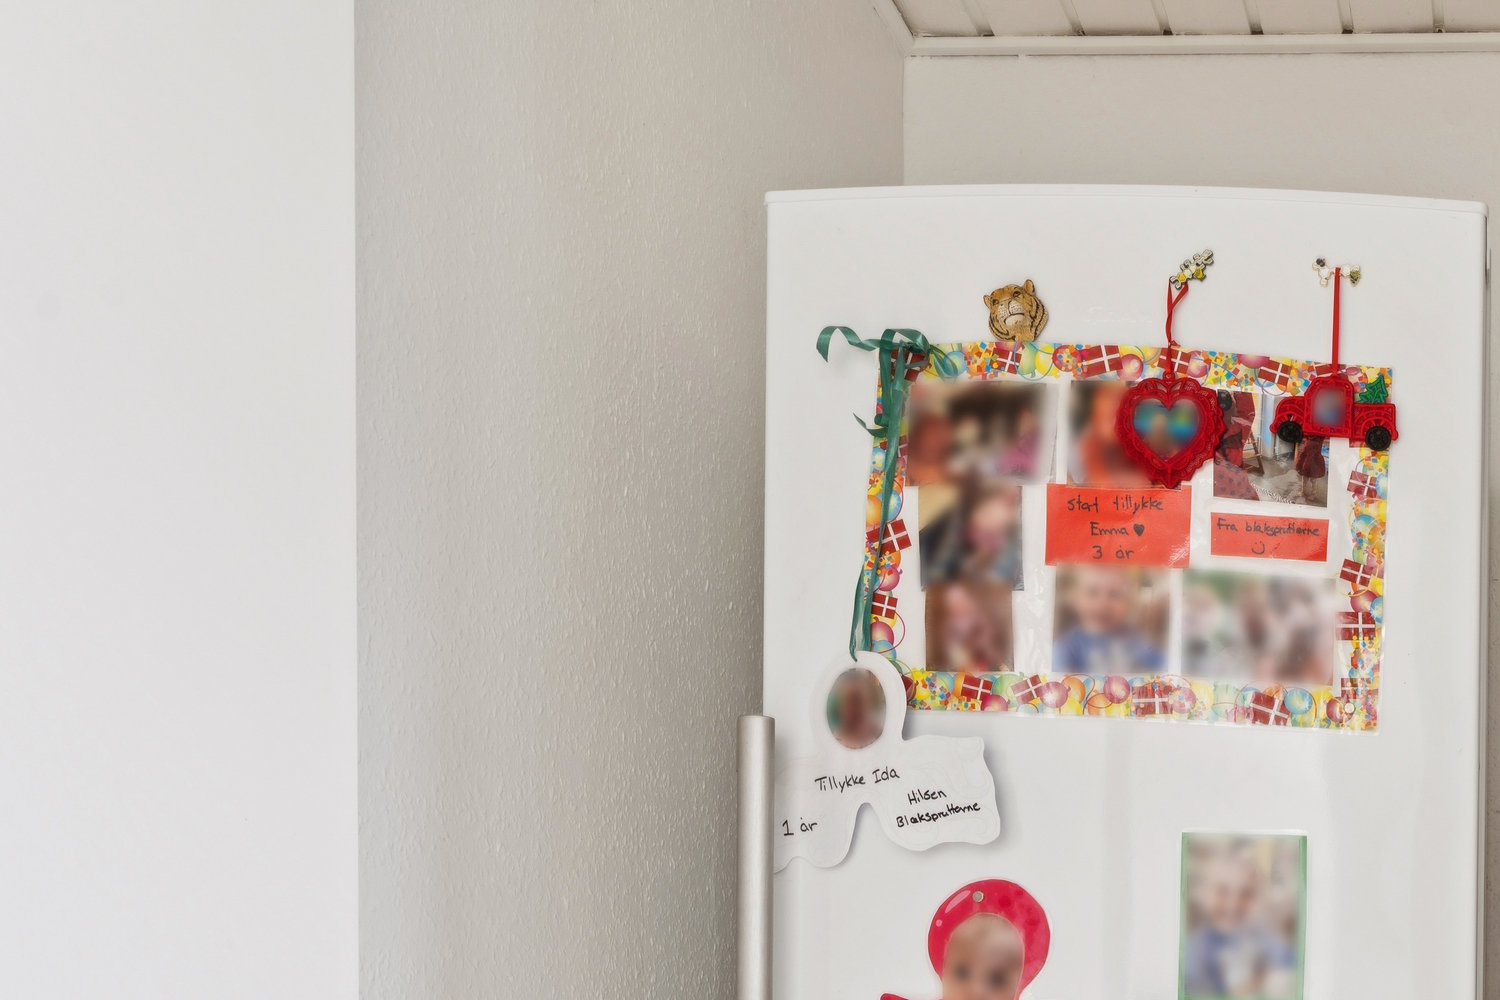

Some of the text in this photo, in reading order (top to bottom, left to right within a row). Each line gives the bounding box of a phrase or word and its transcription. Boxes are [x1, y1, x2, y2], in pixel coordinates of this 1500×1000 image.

[1113, 494, 1164, 515] tillykke
[1089, 521, 1130, 536] Emma
[1217, 517, 1238, 532] Fra
[1092, 544, 1135, 559] 3 år
[814, 766, 900, 793] Tillykke Ida
[907, 788, 947, 805] Hilsen
[782, 816, 818, 836] 1 år
